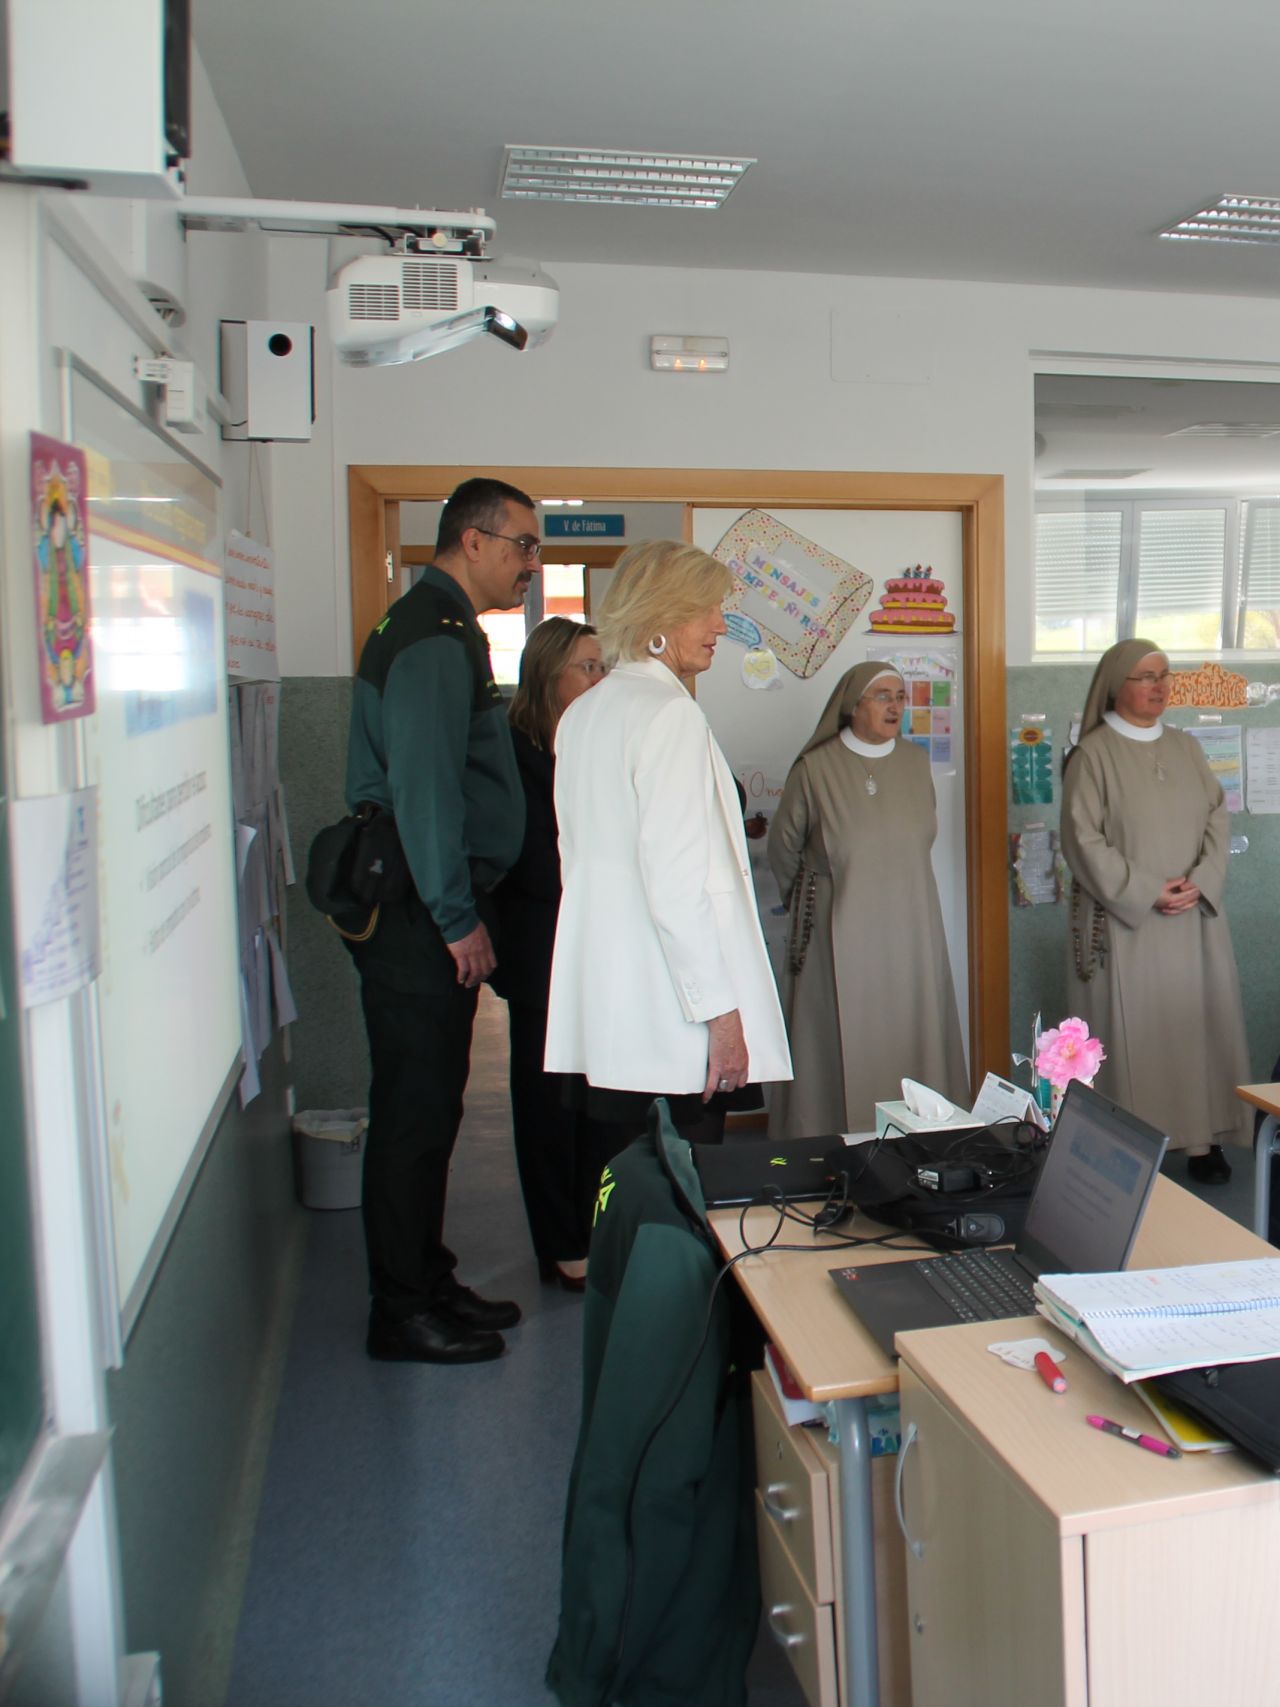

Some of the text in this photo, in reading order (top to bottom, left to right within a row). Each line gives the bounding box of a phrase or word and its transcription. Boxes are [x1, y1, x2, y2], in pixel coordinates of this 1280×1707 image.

[572, 519, 581, 532] de
[582, 518, 607, 532] Fátima
[751, 555, 821, 608] MENSAJES
